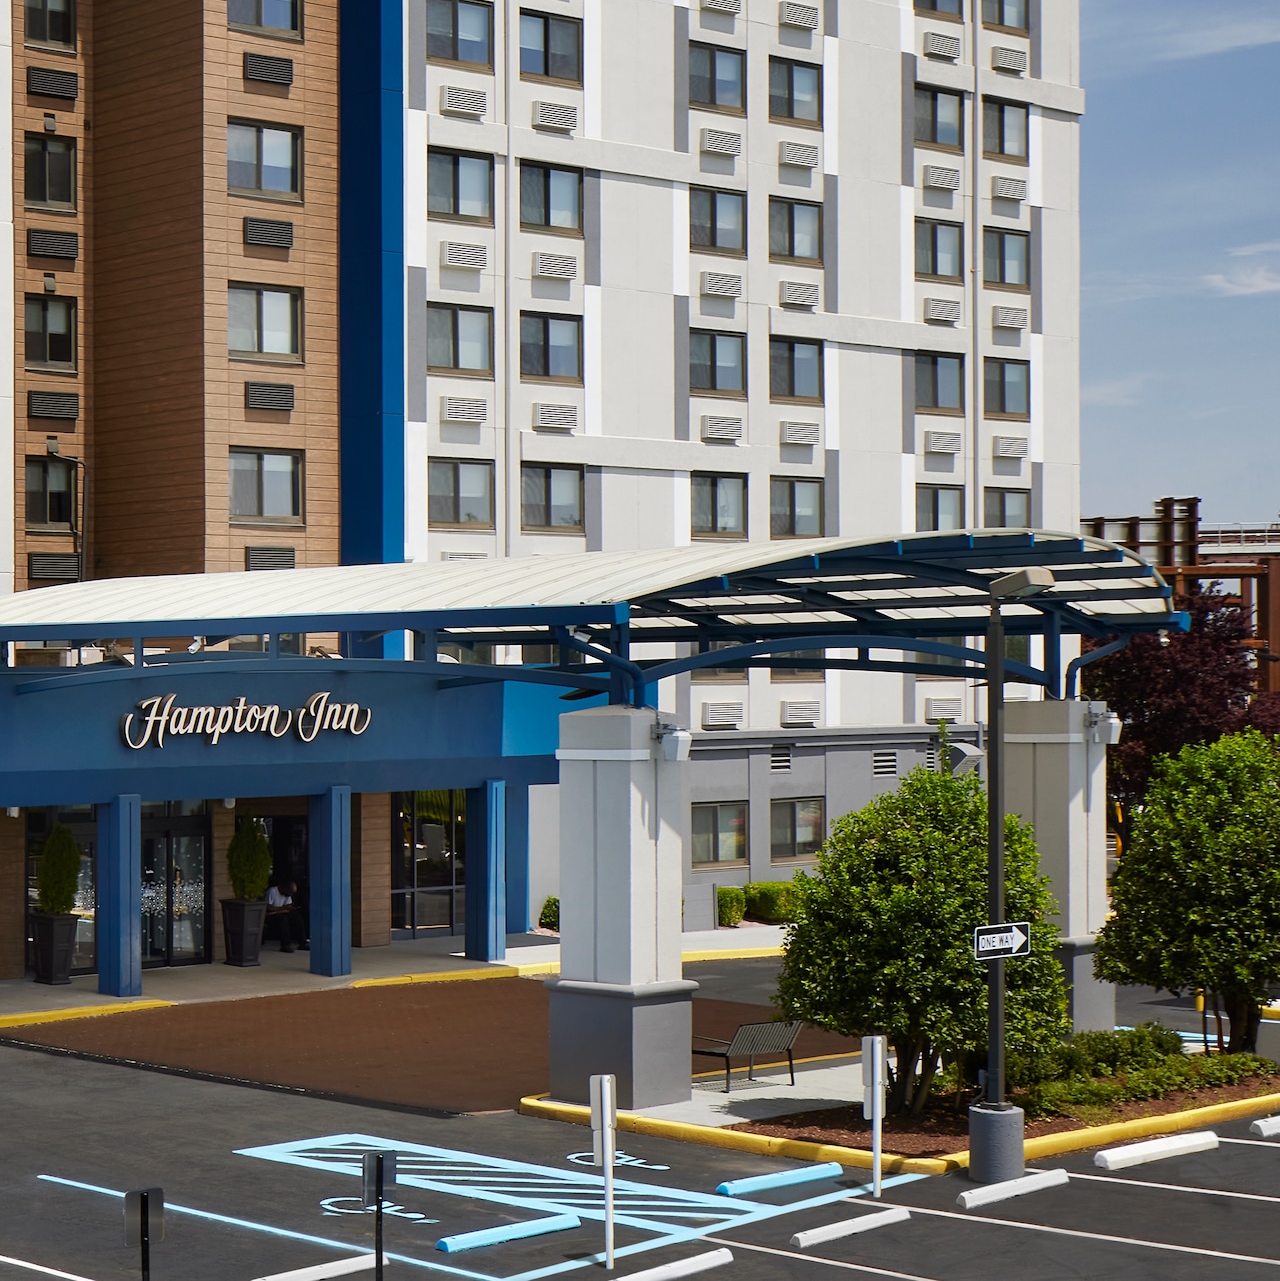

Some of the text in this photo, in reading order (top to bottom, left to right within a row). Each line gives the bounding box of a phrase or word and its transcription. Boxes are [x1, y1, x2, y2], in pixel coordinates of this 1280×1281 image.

[122, 691, 372, 750] Hampton Inn
[980, 934, 1015, 949] ONE WAY
